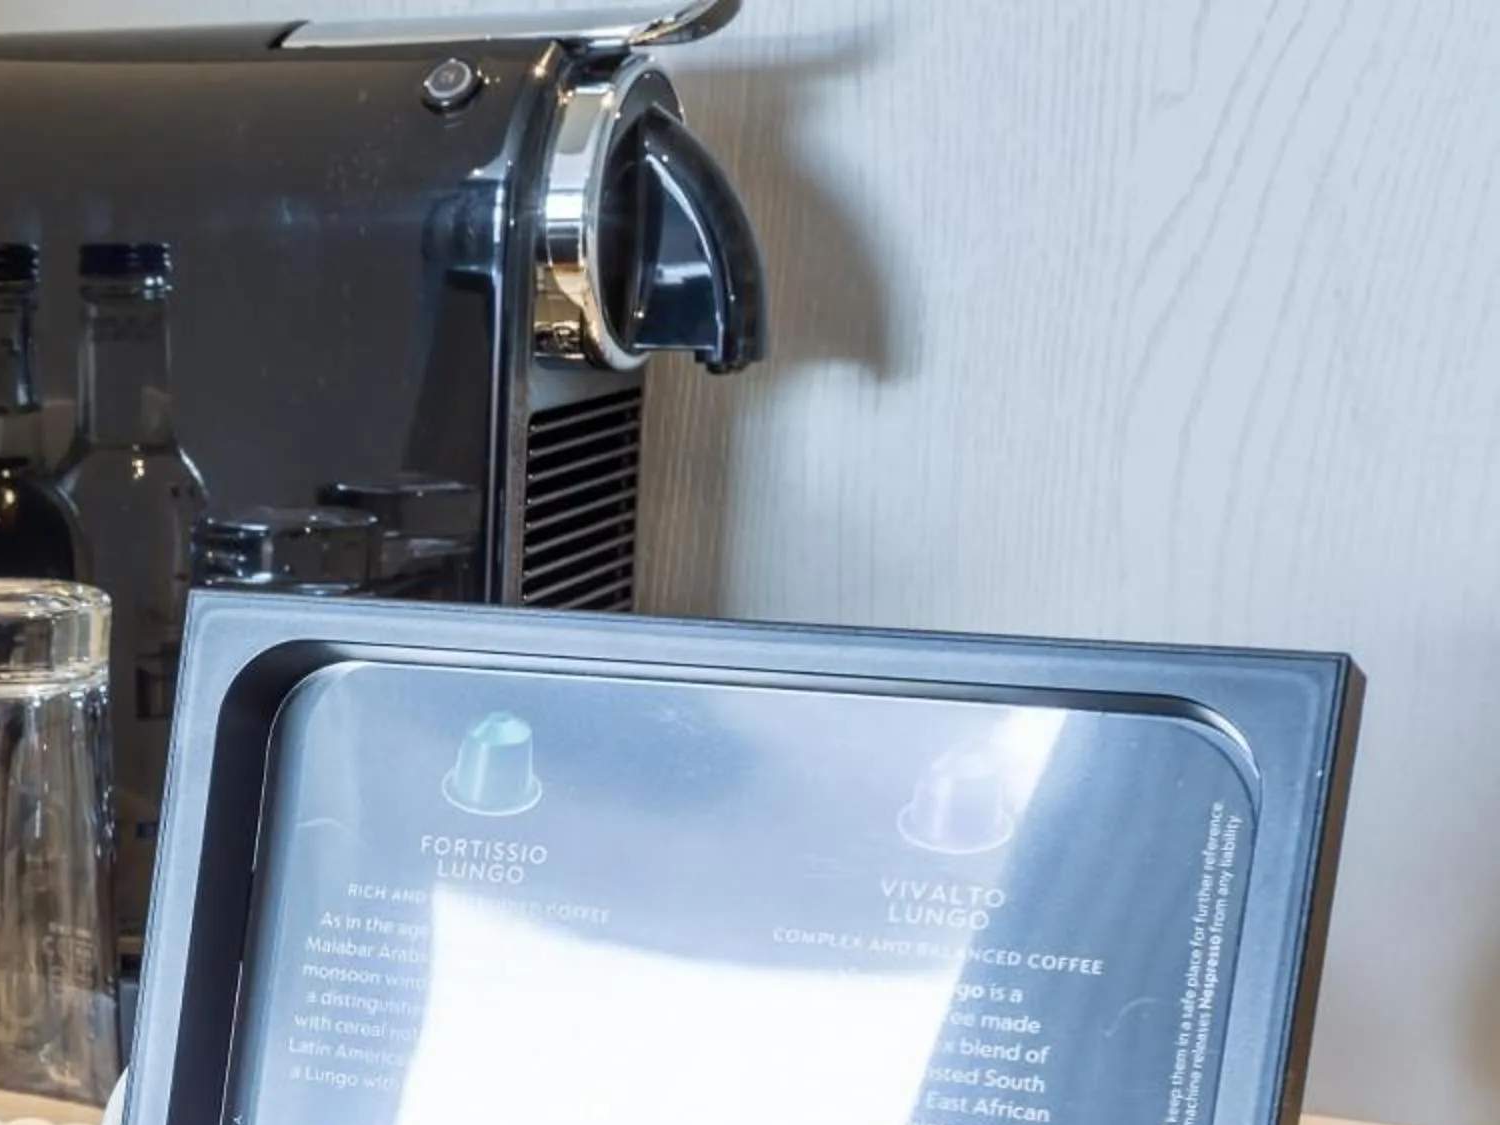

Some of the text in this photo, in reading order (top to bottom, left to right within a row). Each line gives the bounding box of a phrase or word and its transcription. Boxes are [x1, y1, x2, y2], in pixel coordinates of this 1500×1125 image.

[1201, 801, 1223, 871] reference
[1220, 814, 1241, 868] liability
[420, 835, 548, 865] FORTISSIO
[436, 859, 524, 884] LUNGO
[1218, 869, 1233, 896] any
[348, 883, 426, 904] RICH AND
[880, 879, 1006, 909] VIVALTO
[1194, 874, 1212, 923] further
[321, 912, 393, 933] As in the
[888, 906, 989, 931] LUNGO
[1210, 897, 1227, 933] from
[305, 937, 373, 958] Malabar
[1190, 926, 1205, 946] for
[773, 927, 1104, 975] COMPLEX AND BALANCED COFFEE
[303, 964, 380, 985] monsoon
[1184, 947, 1204, 987] place
[1199, 934, 1224, 1011] Nespresso
[306, 989, 423, 1016] a distinguishe
[989, 981, 1006, 1001] is
[1009, 987, 1023, 1003] a
[1180, 988, 1196, 1019] safe
[294, 1013, 385, 1038] with cereal
[980, 1011, 1043, 1035] made
[1180, 1020, 1191, 1031] a
[289, 1036, 331, 1058] Latin
[960, 1039, 1021, 1063] blend
[1025, 1045, 1052, 1065] of
[1176, 1032, 1189, 1046] in
[1191, 1011, 1211, 1069] releases
[305, 1066, 358, 1089] Lungo
[1170, 1048, 1187, 1085] them
[985, 1069, 1045, 1093] South
[925, 1090, 1051, 1123] East African
[1165, 1087, 1183, 1123] keep
